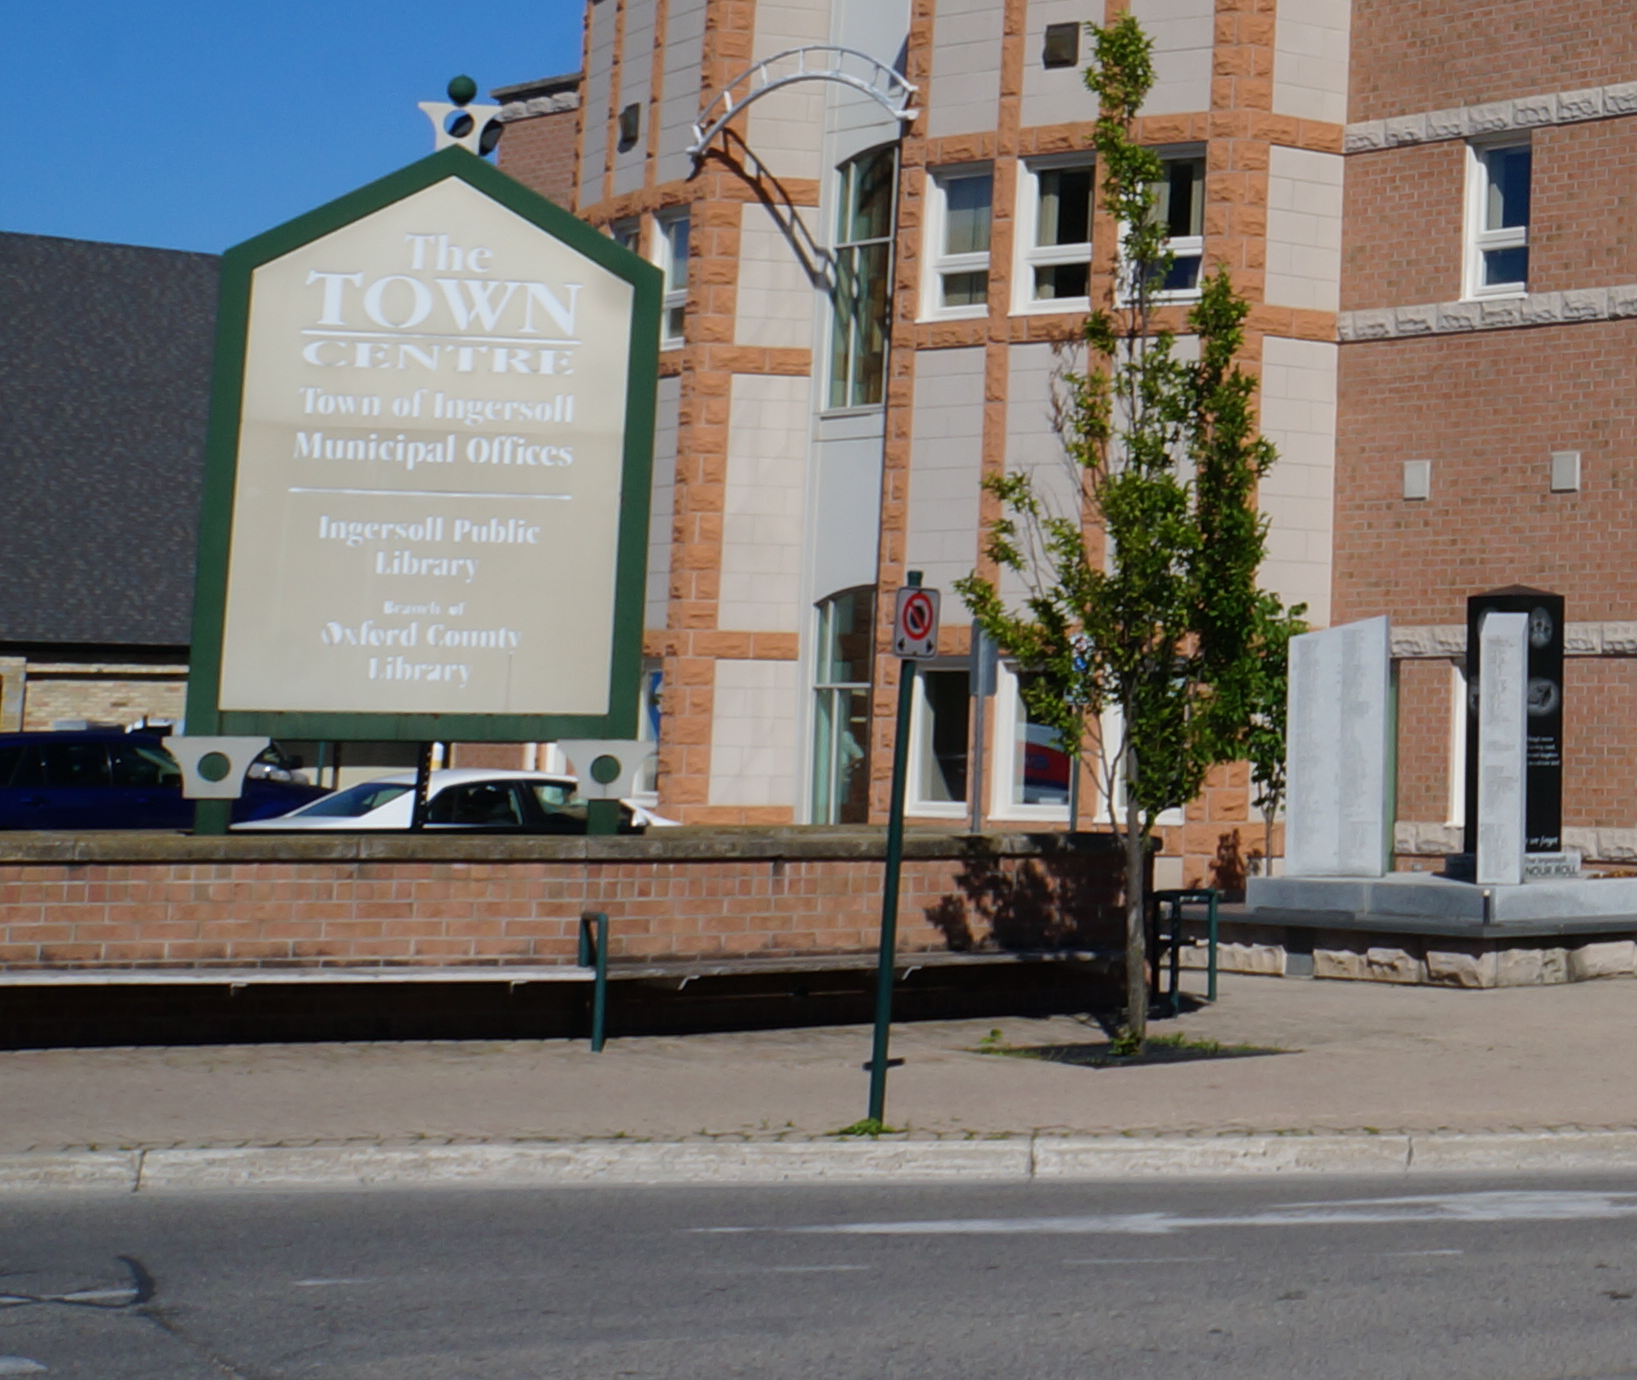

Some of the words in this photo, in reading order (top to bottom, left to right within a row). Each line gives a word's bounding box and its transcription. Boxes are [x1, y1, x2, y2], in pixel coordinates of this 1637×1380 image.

[404, 232, 494, 274] The
[305, 269, 584, 337] TOWN
[302, 339, 575, 376] CENTRE
[299, 386, 382, 416] Town
[392, 388, 429, 417] of
[433, 392, 576, 427] Ingersoll
[293, 431, 456, 470] Municipal
[465, 435, 575, 467] Offices
[318, 515, 444, 547] Ingersoll
[453, 518, 541, 544] Public
[375, 550, 480, 583] Library
[383, 600, 441, 615] Branch
[447, 601, 466, 616] of
[320, 620, 418, 647] Oxford
[426, 623, 523, 655] County
[368, 655, 473, 688] Library
